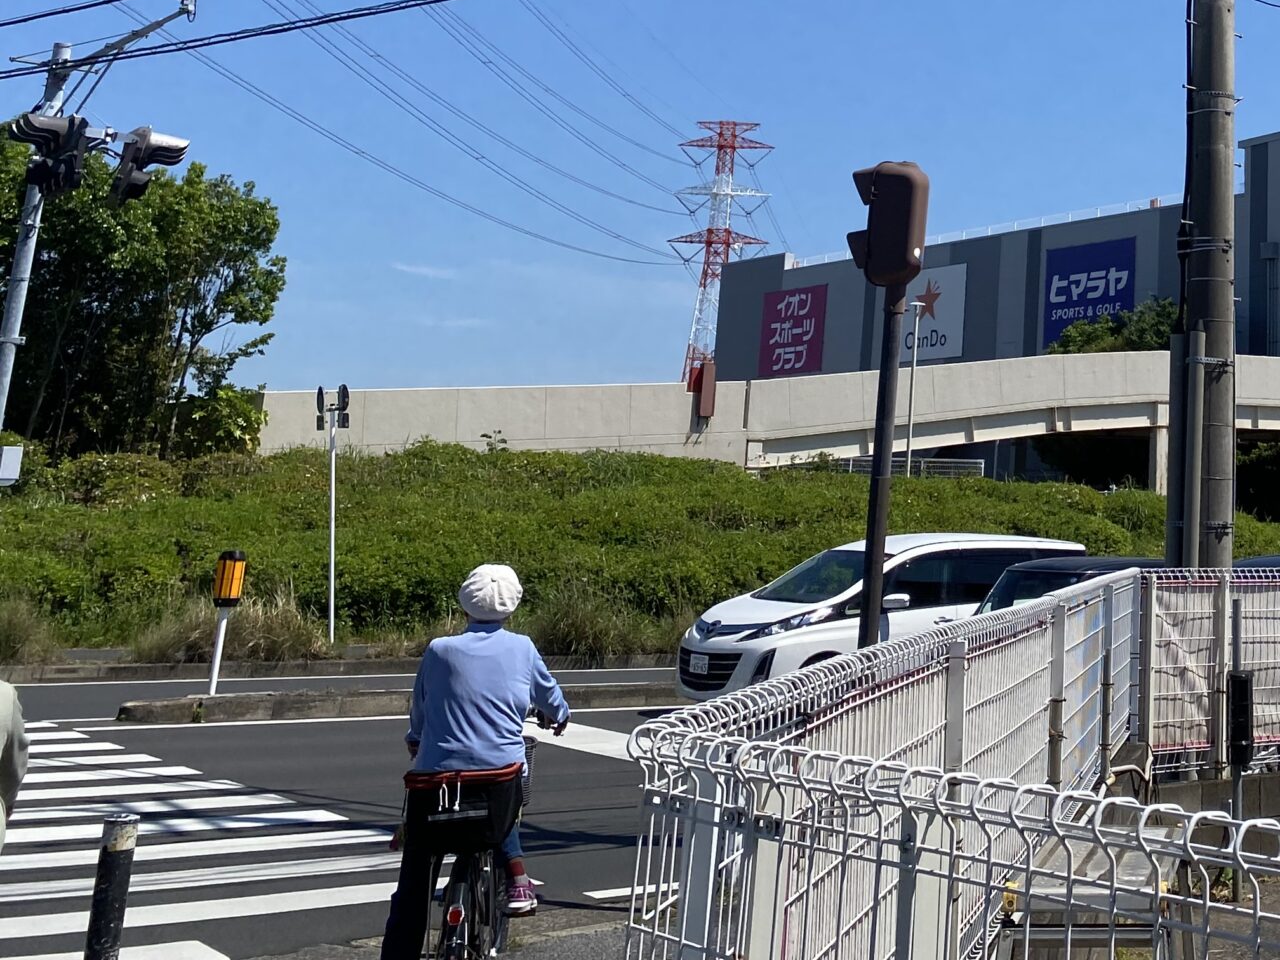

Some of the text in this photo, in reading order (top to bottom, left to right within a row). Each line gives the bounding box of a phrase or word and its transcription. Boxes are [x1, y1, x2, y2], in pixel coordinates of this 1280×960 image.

[1050, 267, 1129, 303] ヒマラヤ
[777, 293, 812, 317] イオン
[1051, 302, 1121, 320] SPORTS & GOLF
[769, 318, 815, 344] スポーツ
[772, 344, 808, 370] クラブ
